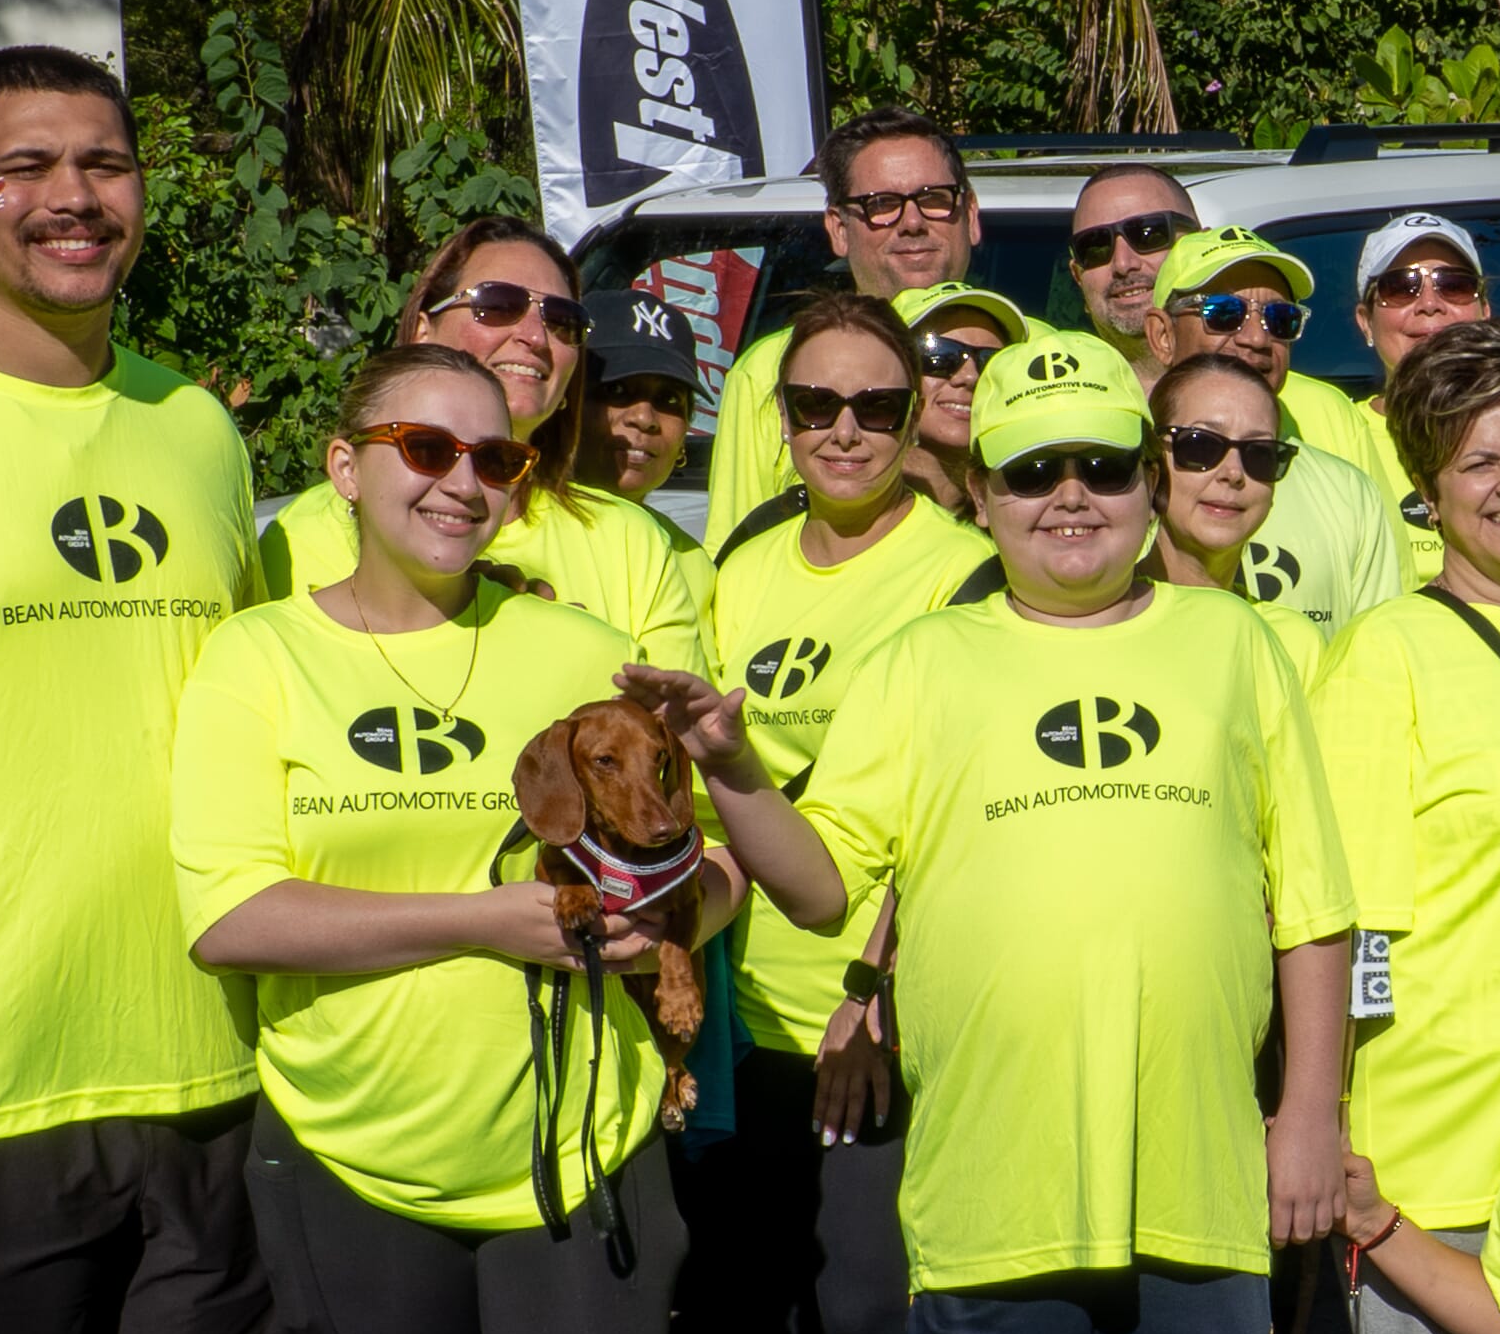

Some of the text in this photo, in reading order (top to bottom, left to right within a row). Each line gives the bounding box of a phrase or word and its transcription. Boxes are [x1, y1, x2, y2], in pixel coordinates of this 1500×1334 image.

[1004, 380, 1109, 408] BEAN AUTOMOTIVE GROUP
[2, 603, 54, 626] BEAN
[58, 598, 168, 620] AUTOMOTIVE
[291, 795, 334, 816] BEAN
[338, 790, 477, 814] AUTOMOTIVE
[984, 794, 1029, 822] BEAN
[1032, 782, 1151, 809] AUTOMOTIVE
